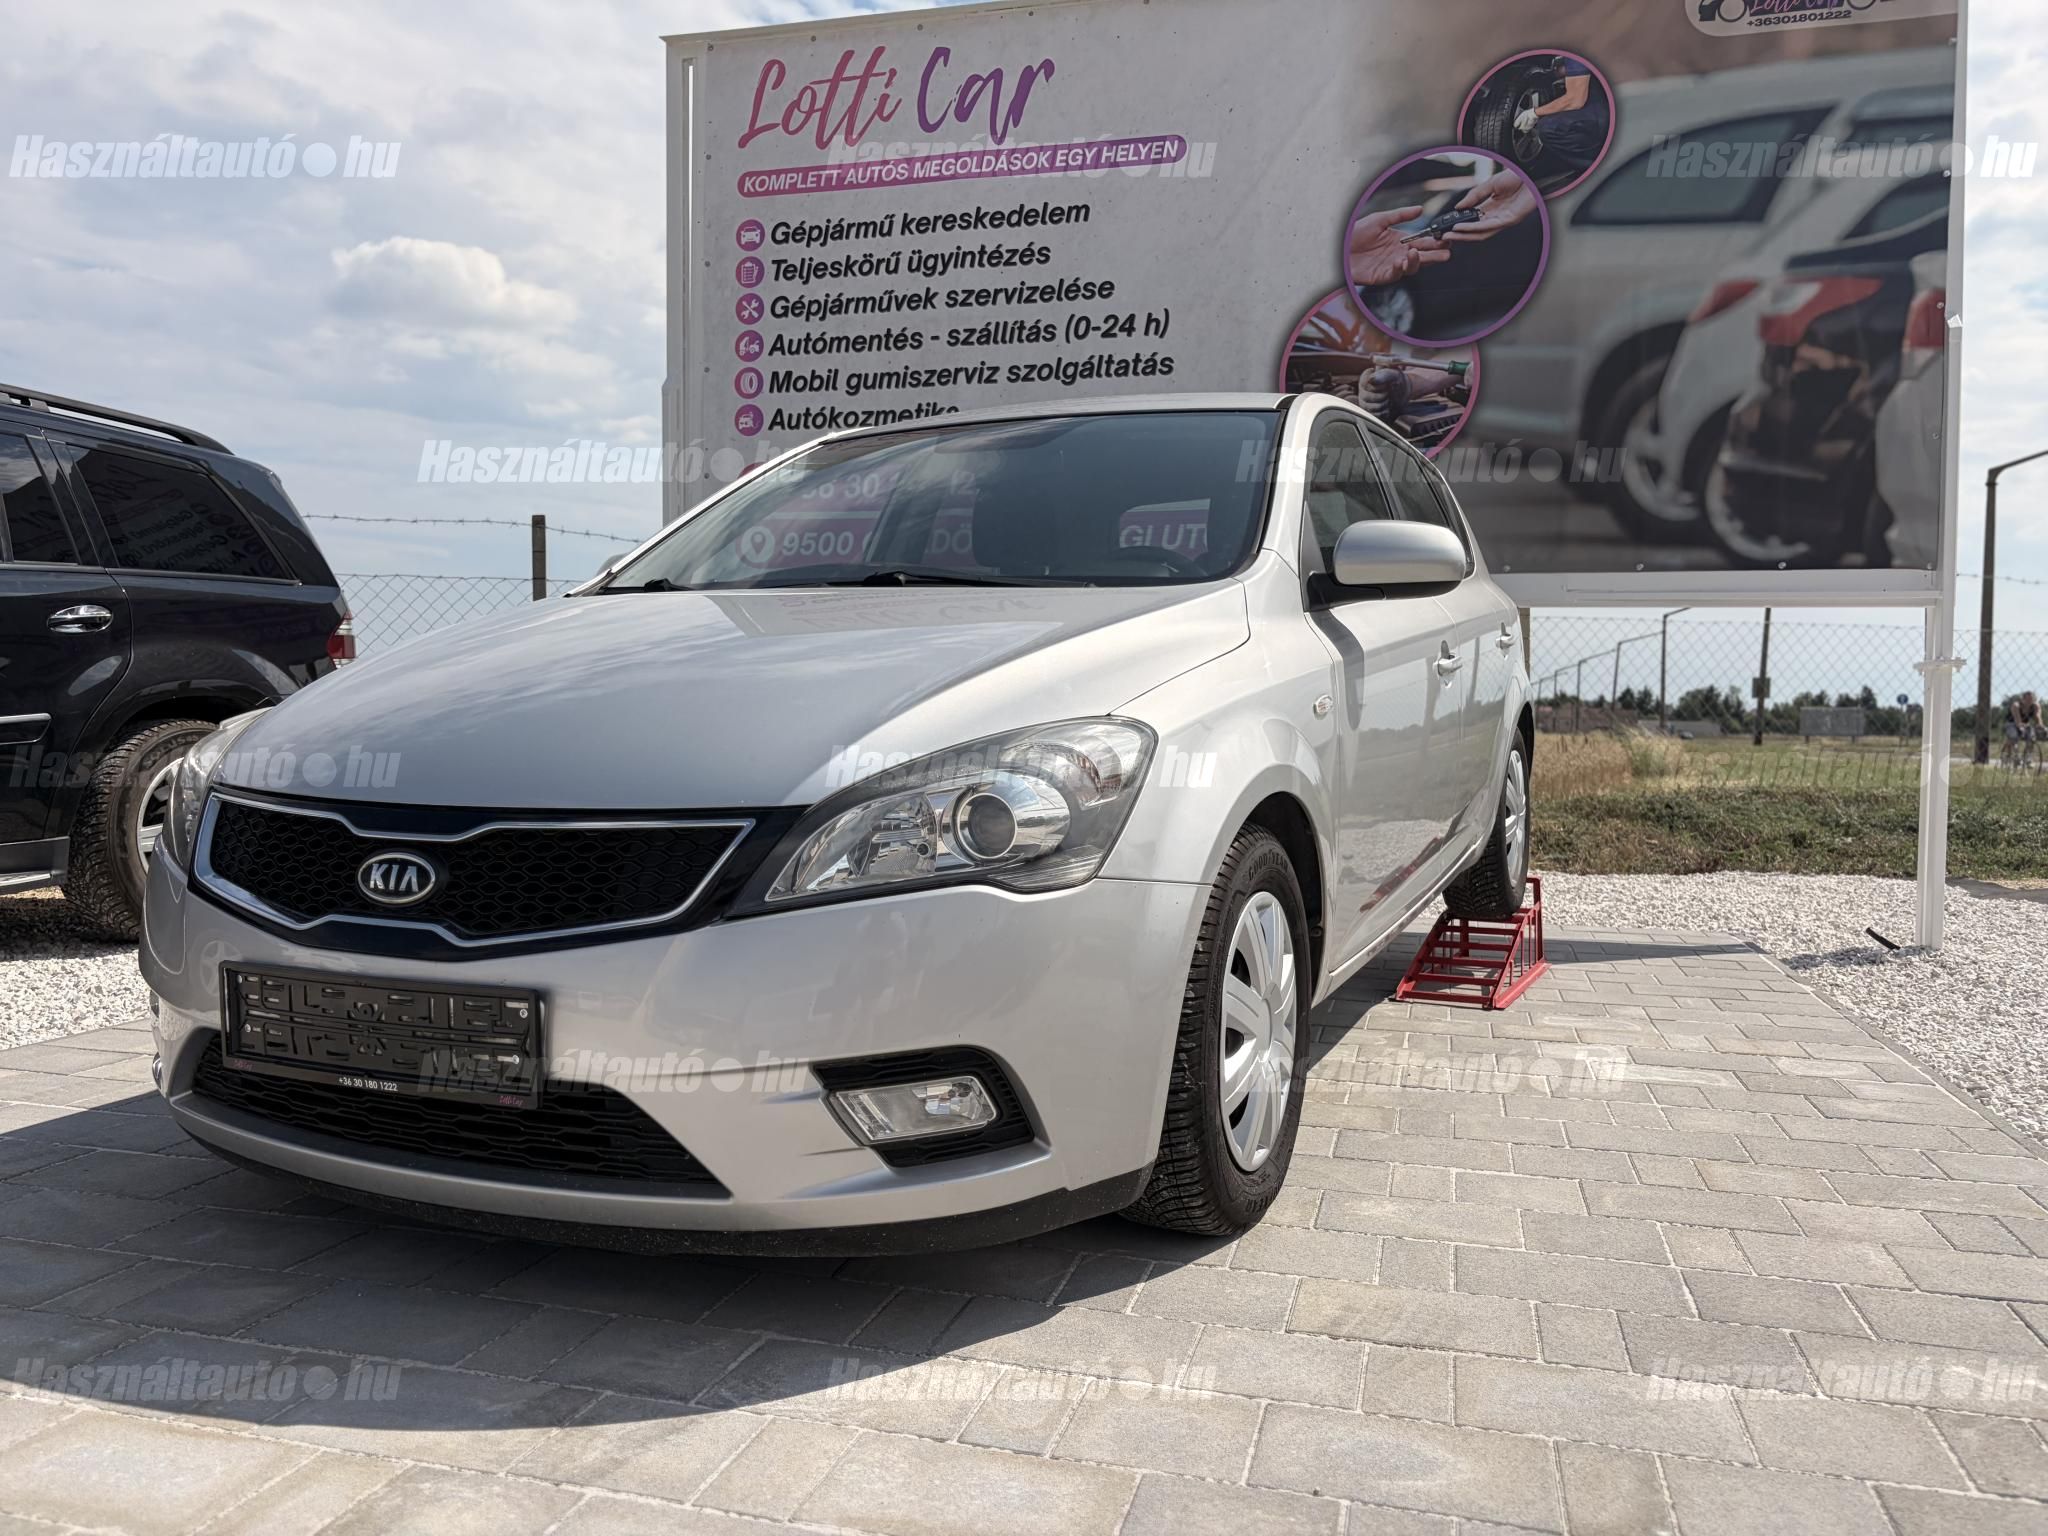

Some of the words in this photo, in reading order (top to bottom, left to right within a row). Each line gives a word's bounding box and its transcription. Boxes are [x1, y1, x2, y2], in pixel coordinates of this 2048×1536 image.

[1746, 10, 1852, 27] +36301801222
[737, 46, 903, 150] Lotti
[915, 46, 1056, 145] Car
[743, 169, 842, 193] KOMPLETT
[843, 159, 909, 185] AUTÓS
[913, 150, 1051, 180] MEGOLDÁSOK
[1055, 147, 1099, 168] EGY
[1101, 140, 1180, 164] HELYEN
[770, 213, 895, 248] Gépjármű
[900, 202, 1091, 237] kereskedelem
[771, 250, 901, 285] Teljeskörű
[907, 243, 1052, 277] ügyintézés
[769, 286, 938, 323] Gépjárművek
[944, 279, 1116, 308] szervizelése
[768, 329, 924, 358] Autómentés
[946, 316, 1057, 347] szállítás
[1064, 313, 1136, 344] (0-24
[1144, 308, 1171, 339] h)
[769, 366, 840, 395] Mobil
[845, 359, 1000, 396] gumiszerviz
[1005, 353, 1176, 386] szolgáltatás
[782, 532, 854, 556] 9500
[369, 863, 419, 892] KIA
[339, 1077, 352, 1086] +36
[353, 1078, 363, 1087] 30
[364, 1079, 378, 1089] 180
[379, 1081, 399, 1091] 1222
